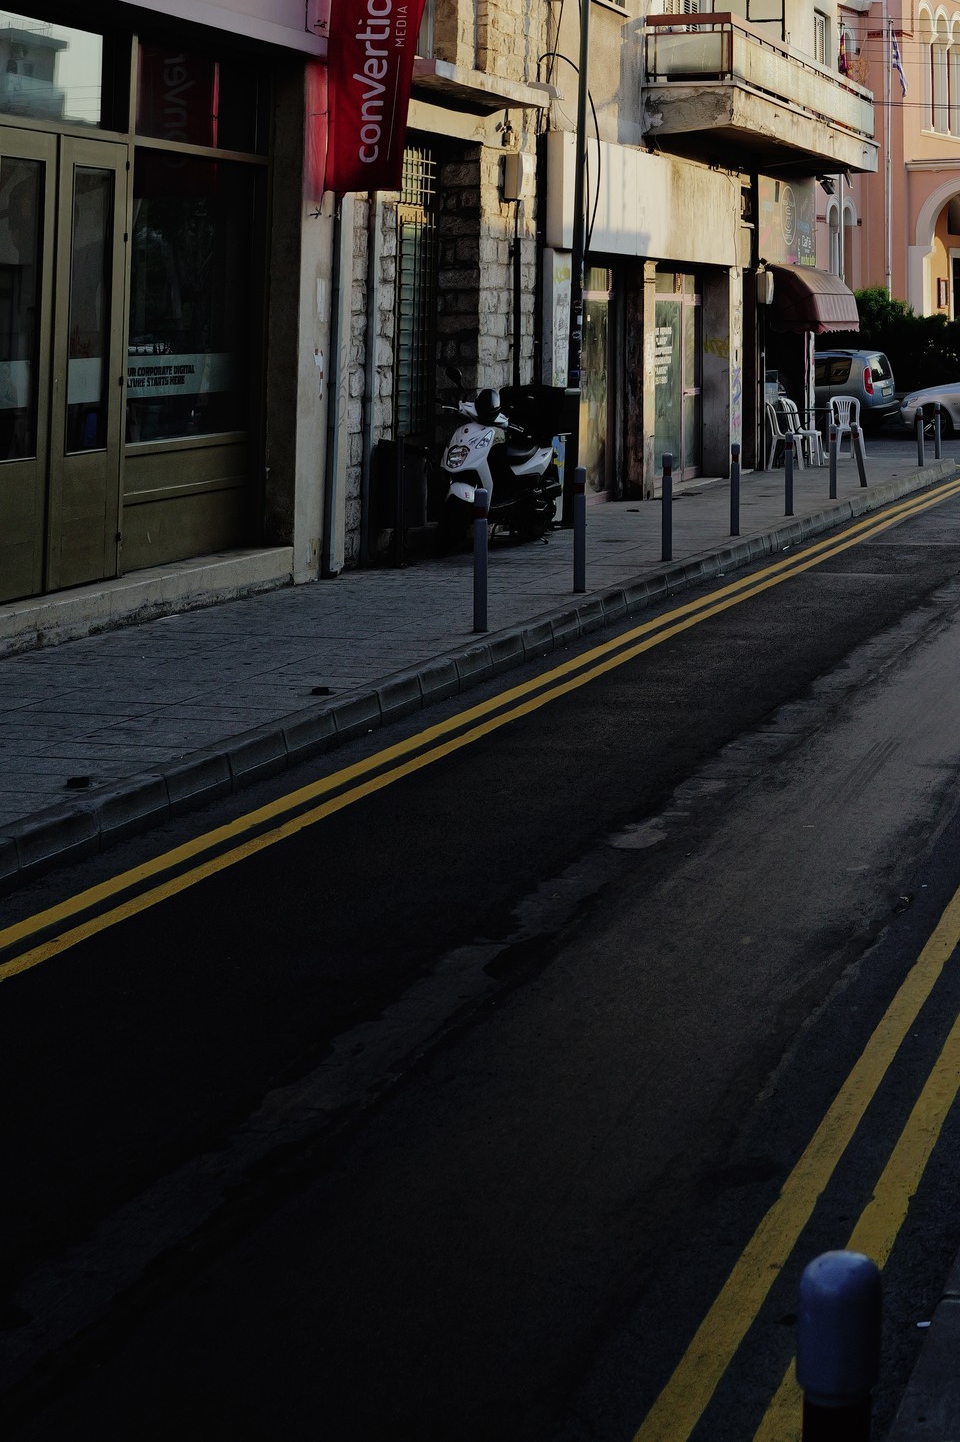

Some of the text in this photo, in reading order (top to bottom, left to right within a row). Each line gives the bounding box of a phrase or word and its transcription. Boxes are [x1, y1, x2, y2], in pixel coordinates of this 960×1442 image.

[395, 5, 408, 47] MEDIA
[138, 366, 172, 376] CORPORATE
[174, 365, 194, 374] DIGITAL
[147, 377, 168, 386] STARTS
[170, 376, 185, 384] HERE
